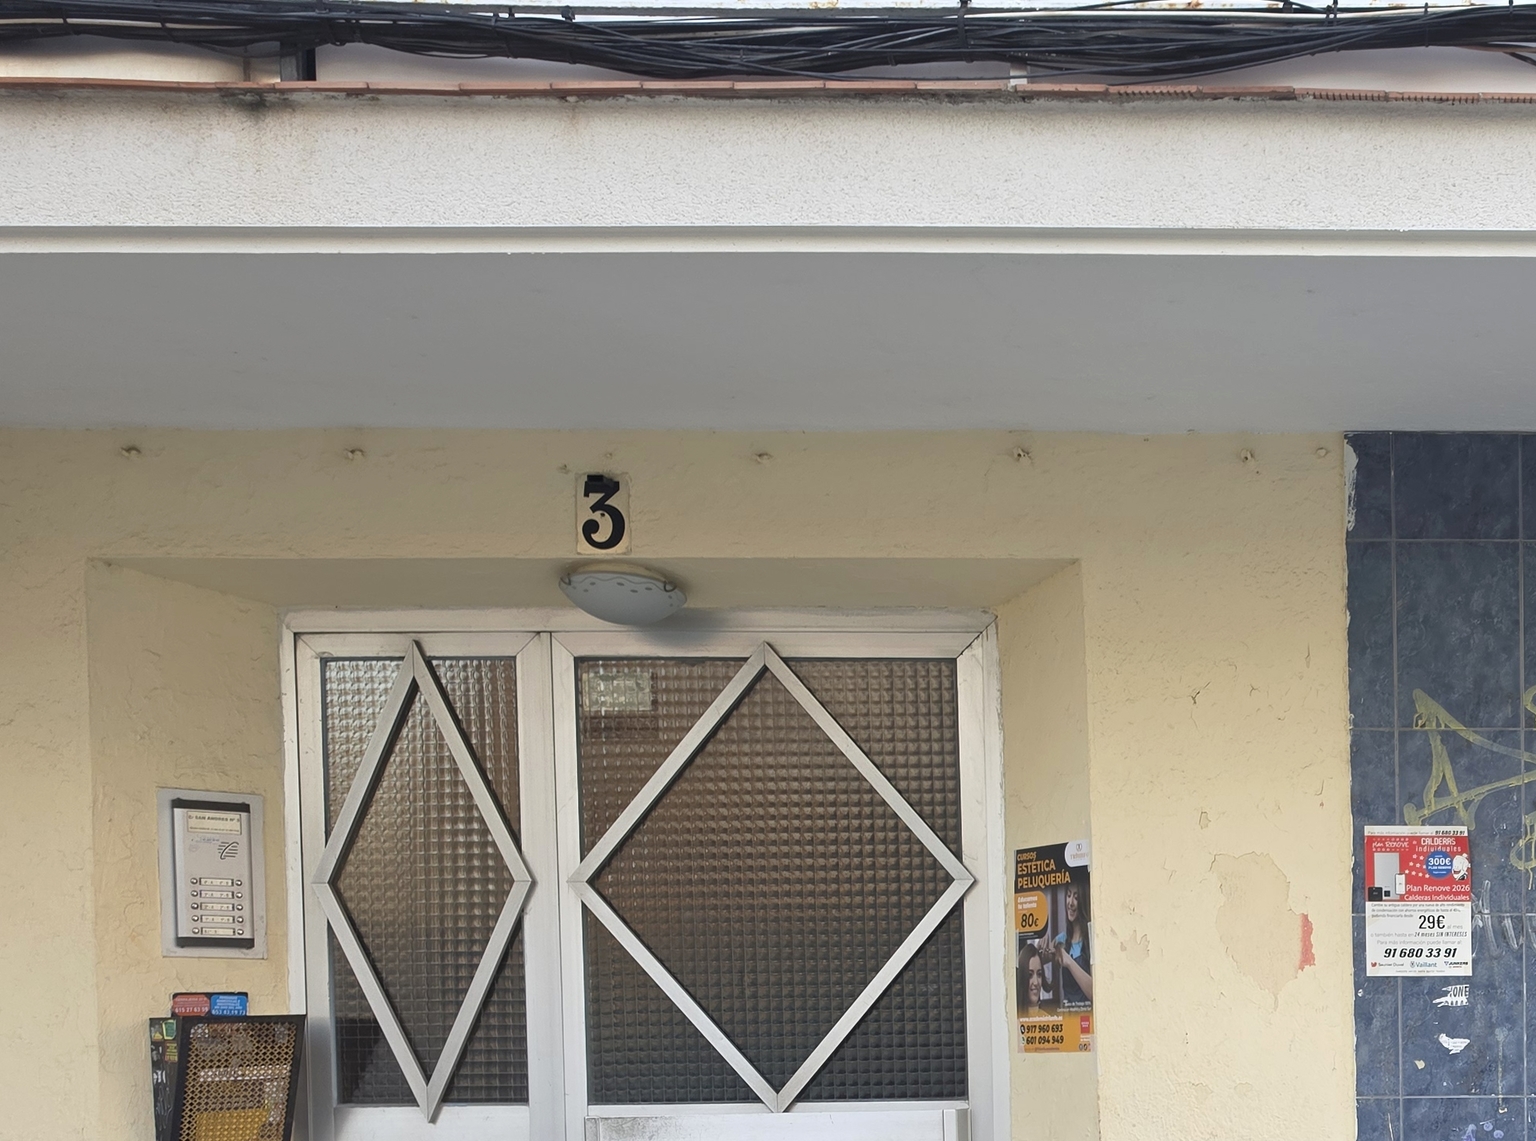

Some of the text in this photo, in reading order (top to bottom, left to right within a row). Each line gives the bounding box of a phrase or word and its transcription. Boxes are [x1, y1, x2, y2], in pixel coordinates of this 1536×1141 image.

[582, 475, 625, 549] 3
[1018, 869, 1071, 889] PELUQUERÍA
[1021, 913, 1039, 928] 80€
[1418, 915, 1445, 929] 29€
[1384, 948, 1457, 958] 91 680 33 91
[1051, 1024, 1063, 1032] 693
[1026, 1036, 1037, 1044] 601
[1052, 1036, 1064, 1044] 949
